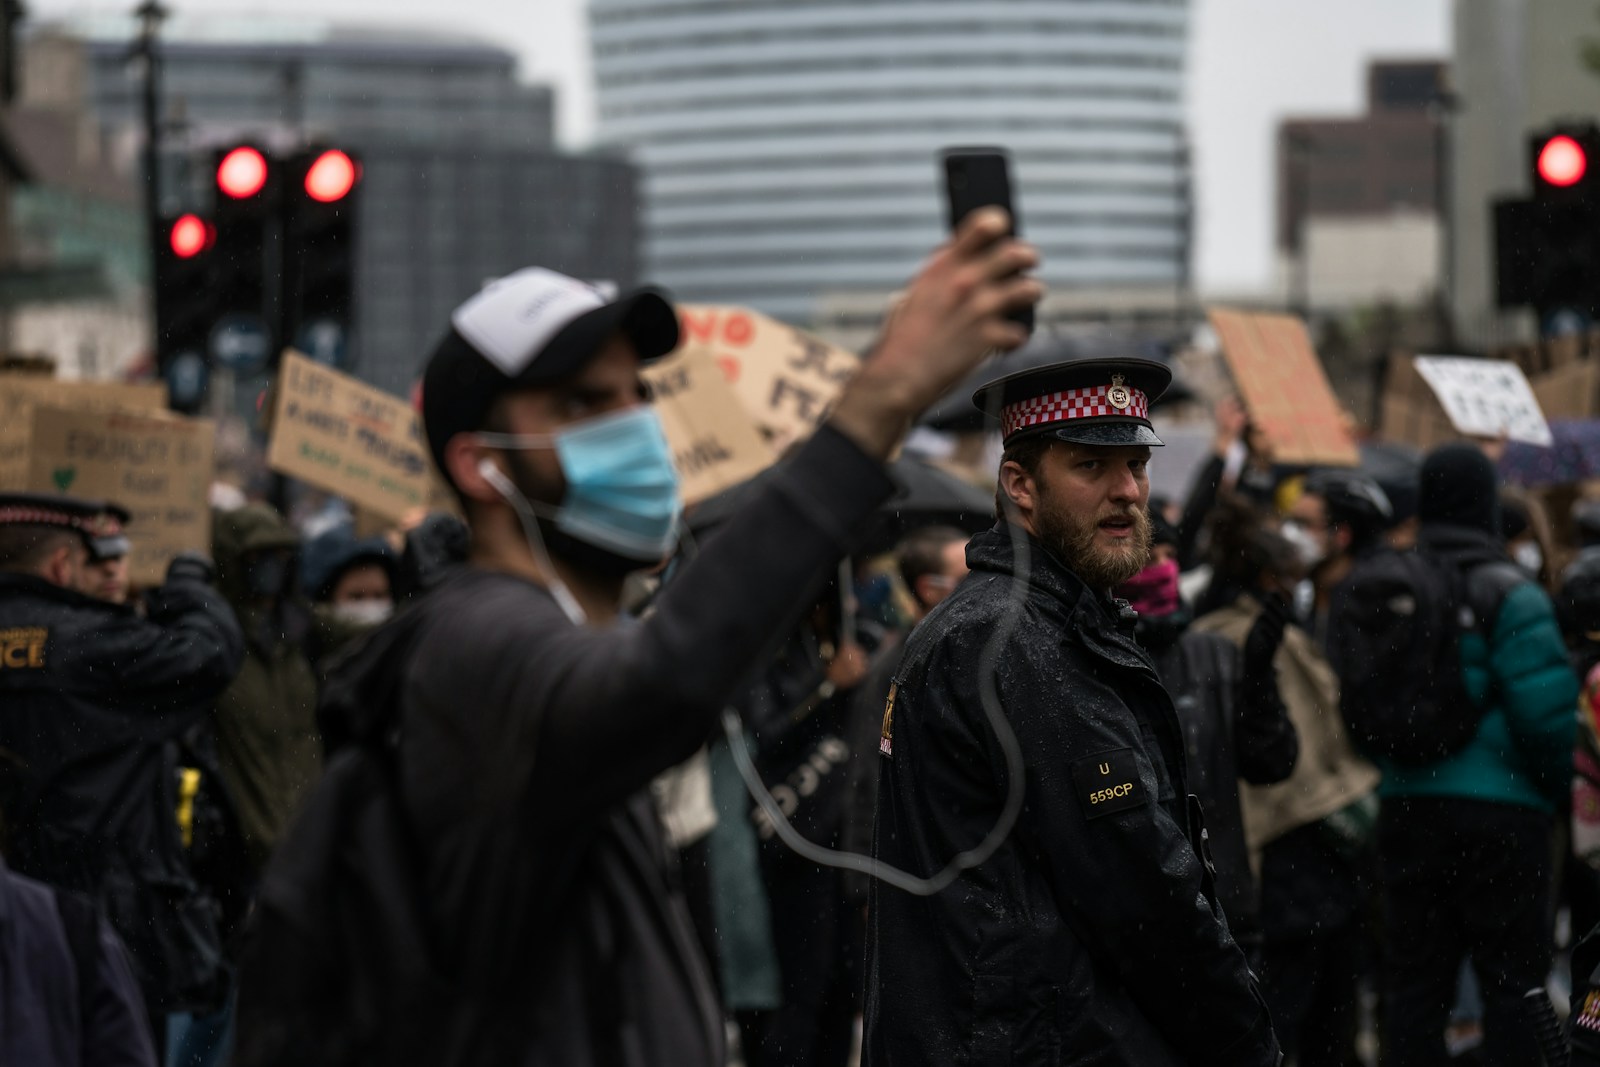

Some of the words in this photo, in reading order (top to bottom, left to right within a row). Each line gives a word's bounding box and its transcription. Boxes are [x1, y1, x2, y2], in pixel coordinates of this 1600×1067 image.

[677, 310, 756, 347] NO
[1099, 762, 1111, 775] U
[1089, 782, 1134, 805] 559CP
